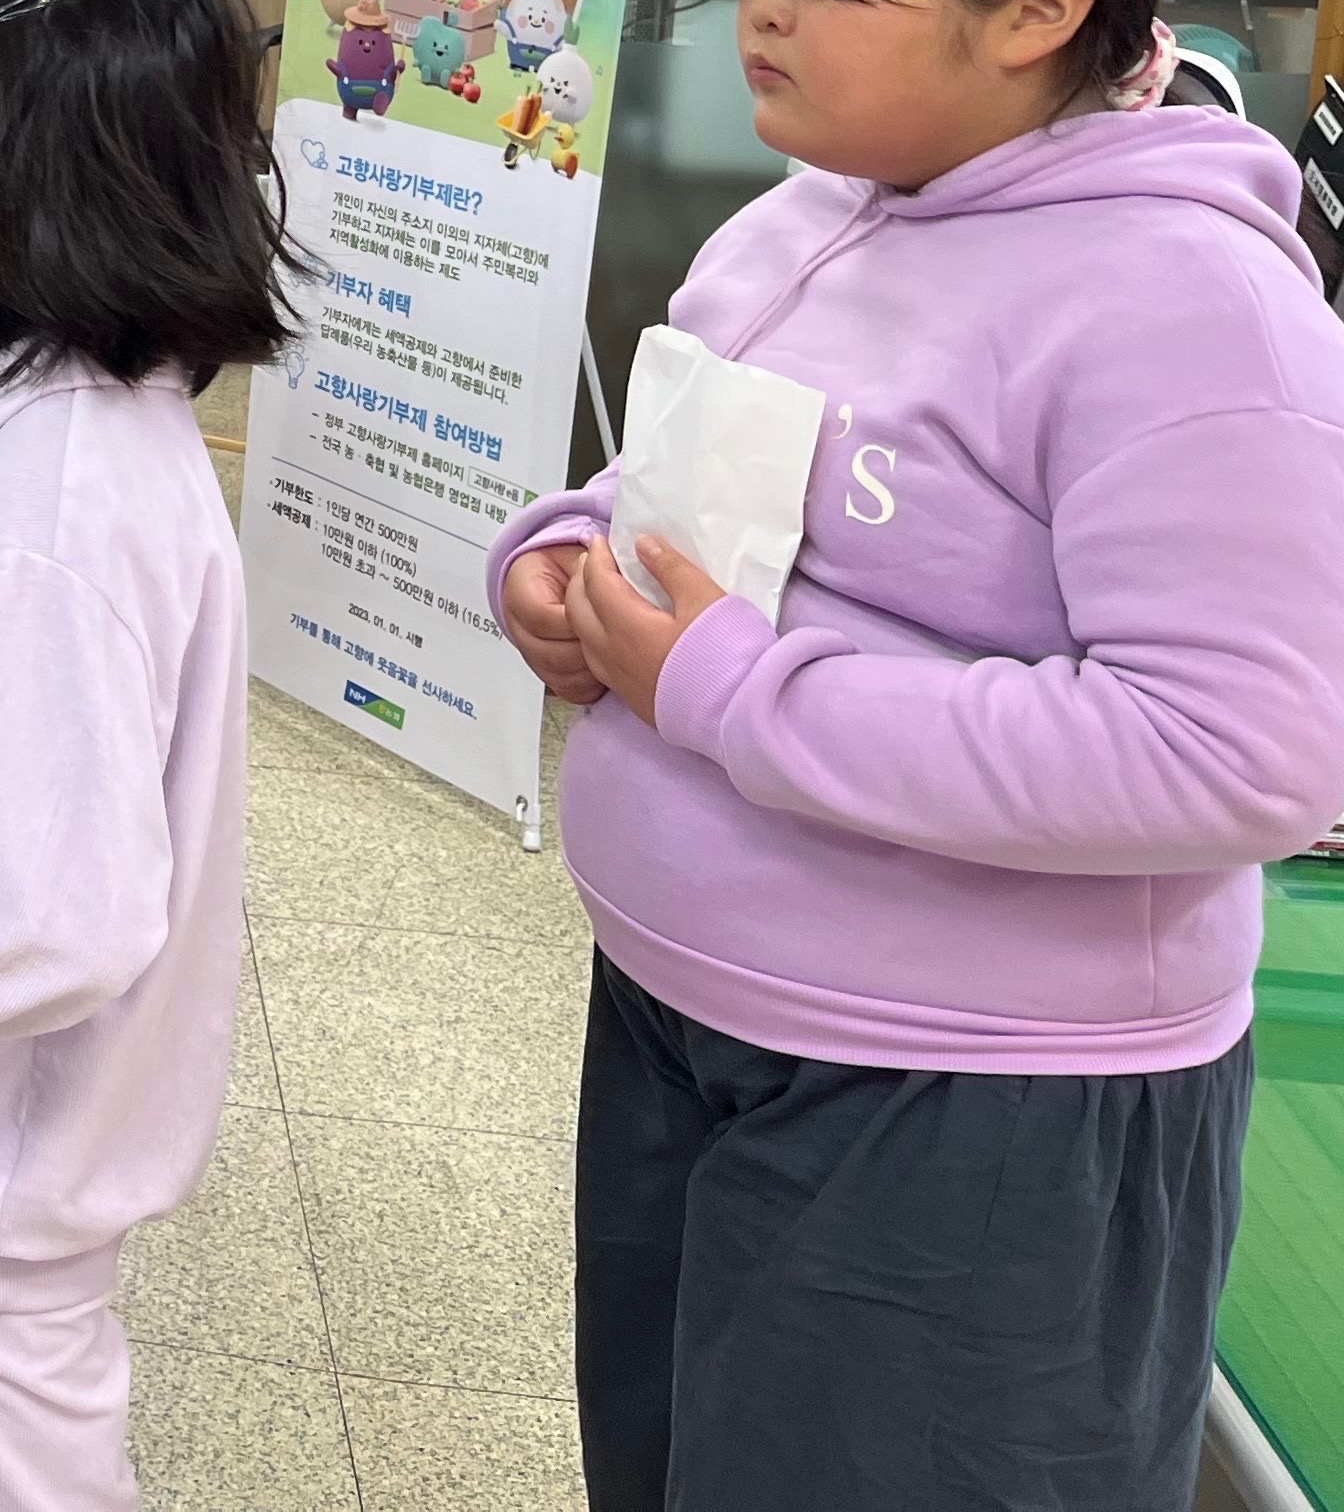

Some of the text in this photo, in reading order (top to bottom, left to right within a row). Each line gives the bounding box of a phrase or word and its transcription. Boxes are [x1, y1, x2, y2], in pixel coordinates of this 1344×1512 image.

[336, 155, 483, 216] 고향사랑기부제란?
[329, 228, 461, 281] 지역활성화에 이용하는 제도
[331, 210, 540, 286] 기부하고 지자체는 이를 모아서 주민복리와
[333, 192, 550, 269] 개인이 자신의 주소지 이외의 지자체(고향)에
[327, 270, 412, 318] 기부자 혜택
[320, 324, 373, 356] 답례품(우리
[376, 344, 418, 372] 농축산물
[450, 372, 509, 406] 제공됩니다.
[322, 306, 523, 390] 기부자에게는 세액공제와 고향에서 준비한
[314, 370, 503, 461] 고향사랑기부제 참여방법
[325, 413, 344, 431] 정부
[346, 421, 418, 462] 고향사랑기부제
[421, 451, 464, 482] 홈페이지
[322, 434, 341, 453] 전국
[389, 461, 399, 479] 및
[403, 465, 445, 498] 농협은행
[448, 483, 481, 513] 영업점
[484, 499, 507, 524] 내방
[323, 522, 354, 549] 10만원
[357, 538, 377, 560] 이하
[380, 547, 417, 577] (100%)
[325, 498, 351, 522] 1인당
[354, 512, 374, 533] 연간
[377, 522, 419, 553] 500만원
[321, 543, 353, 569] 10만원
[356, 558, 376, 579] 초과
[393, 575, 433, 607] 500만원
[437, 595, 459, 619] 이하
[290, 613, 478, 720] 기부를 통해 고향에 웃음꽃을 선사하세요.
[349, 687, 368, 705] NH
